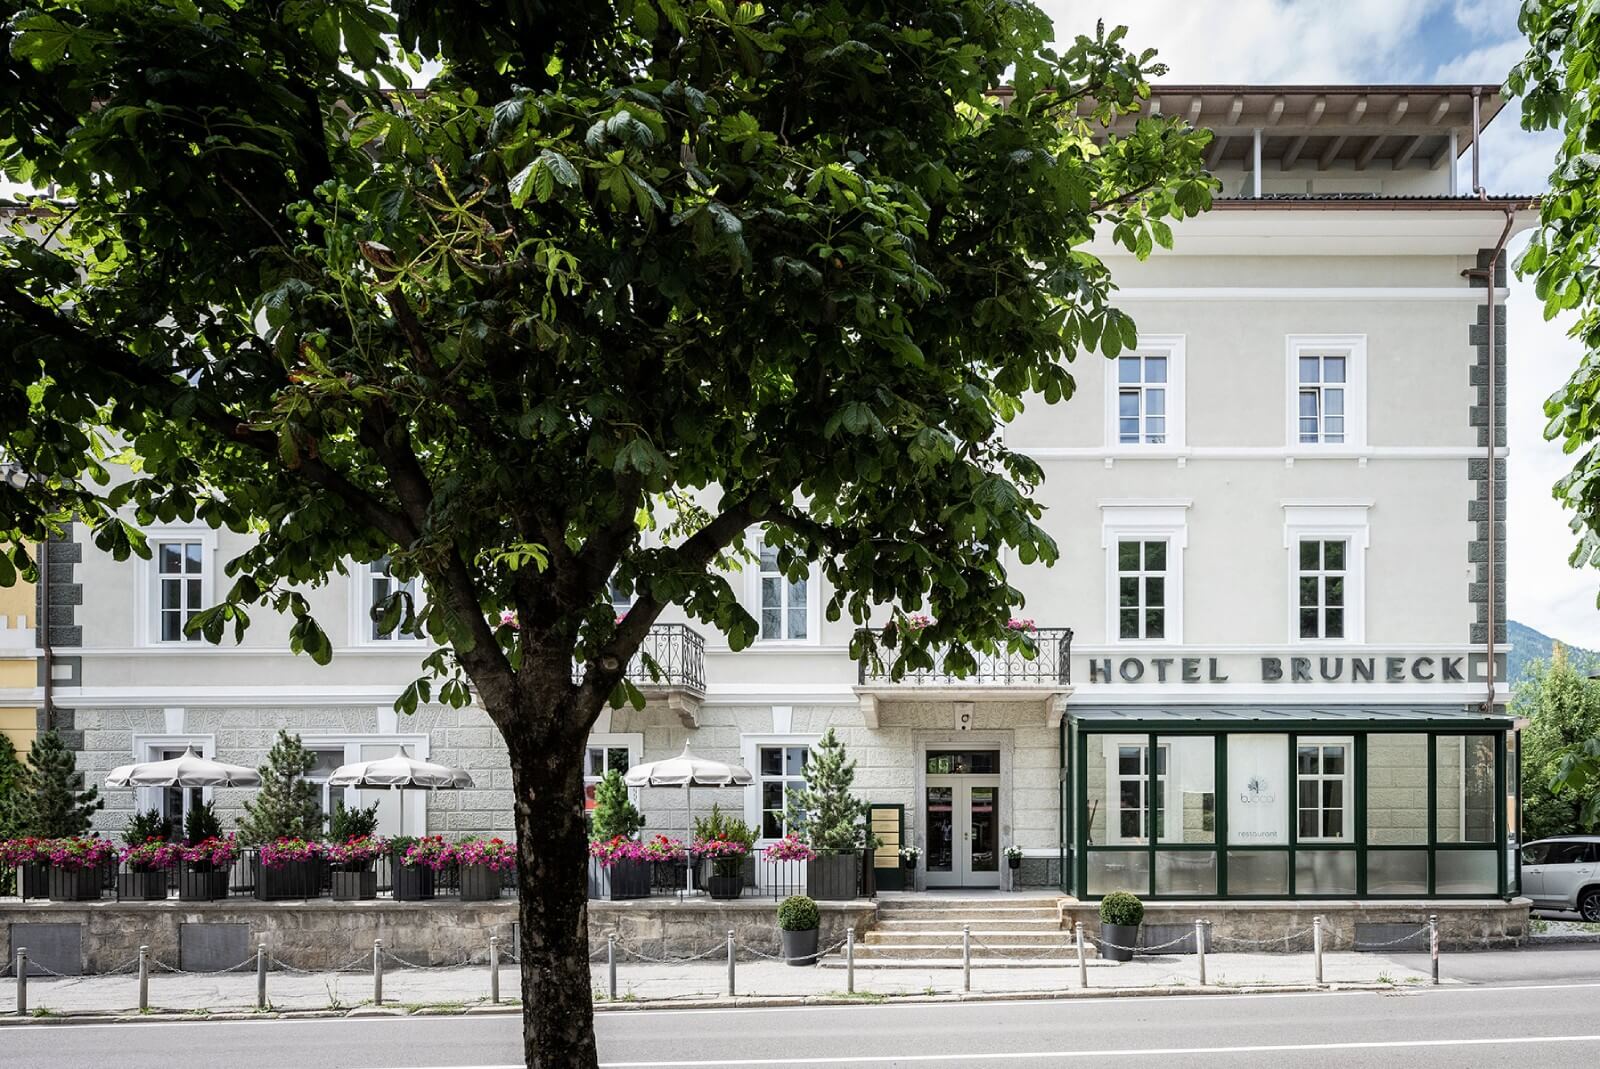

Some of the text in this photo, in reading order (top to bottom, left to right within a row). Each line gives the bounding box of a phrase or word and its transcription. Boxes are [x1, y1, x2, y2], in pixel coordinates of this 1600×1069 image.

[1089, 656, 1466, 684] HOTEL BRUNECK
[1238, 830, 1278, 838] restaurant
